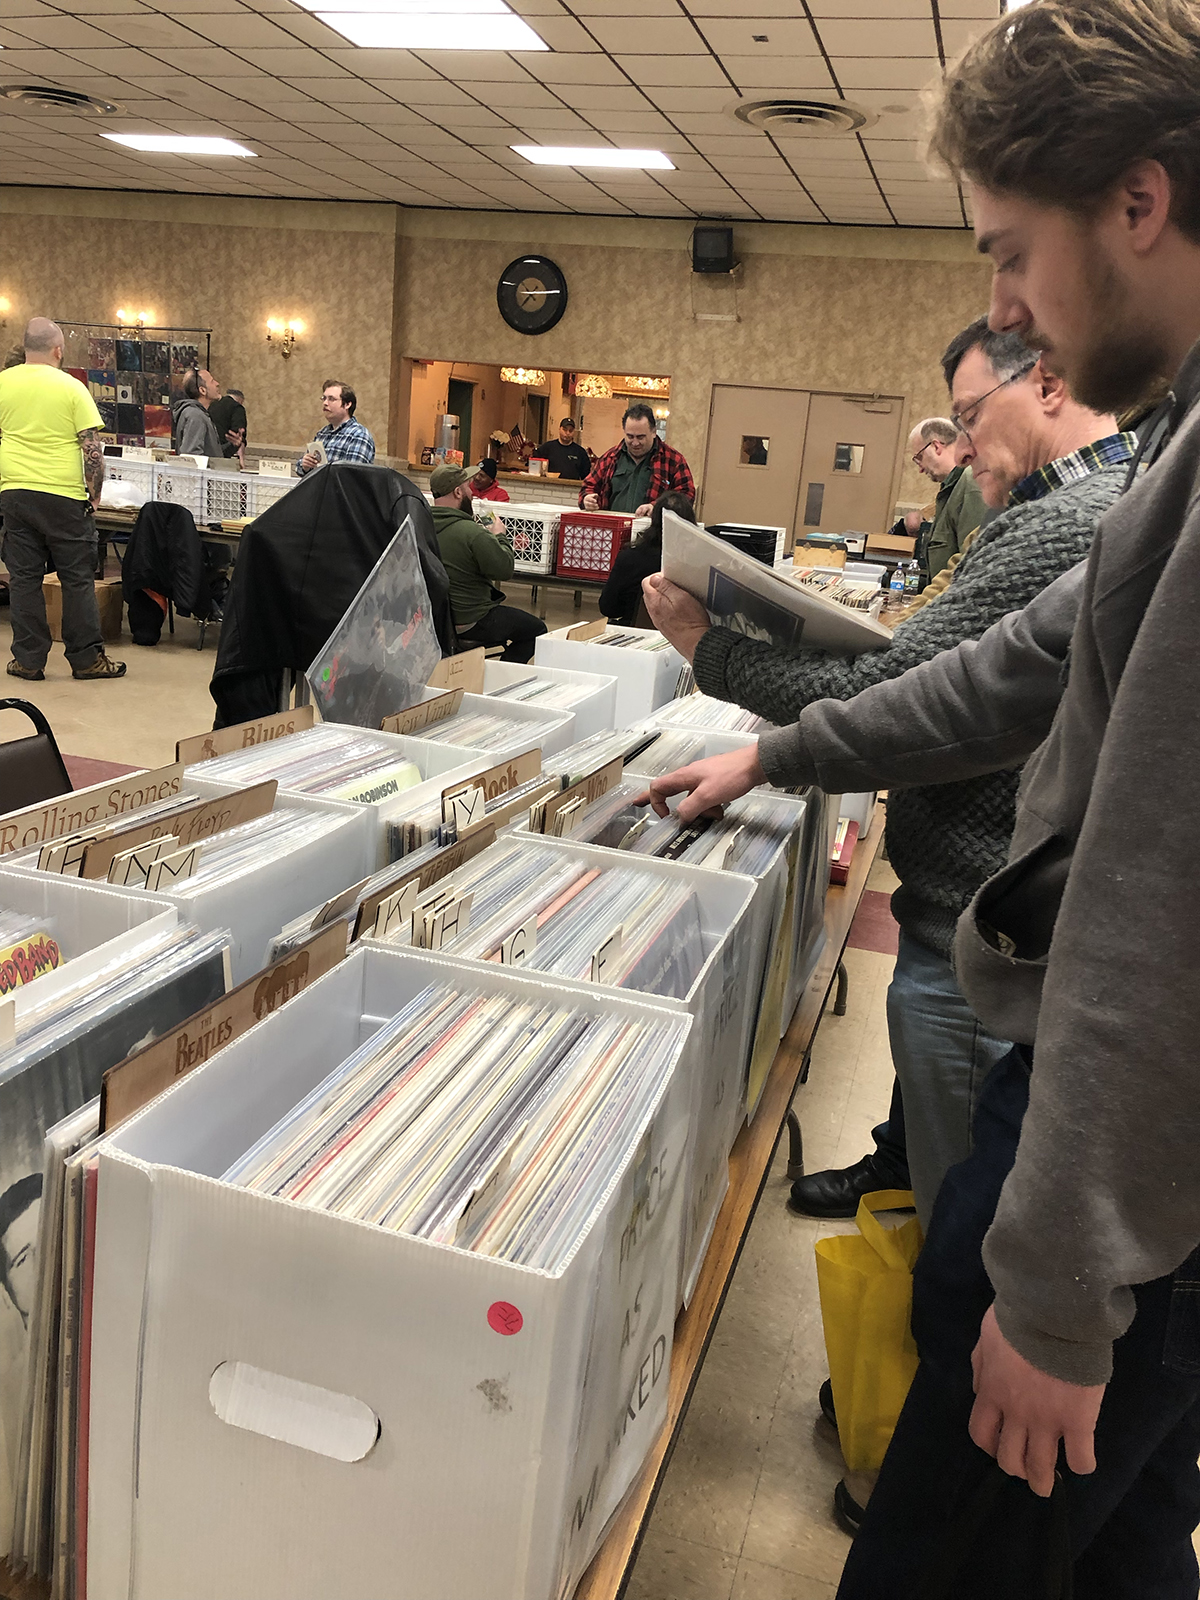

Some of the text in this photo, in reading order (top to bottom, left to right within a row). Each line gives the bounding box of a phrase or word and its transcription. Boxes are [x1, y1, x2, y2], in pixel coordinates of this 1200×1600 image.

[242, 720, 295, 749] Blues
[0, 777, 180, 855] Rolling Stones
[156, 848, 196, 890] M
[383, 886, 408, 935] K
[440, 899, 463, 947] H
[11, 936, 59, 985] BAND
[510, 929, 526, 964] G
[174, 1015, 233, 1076] BEATLES
[200, 1014, 213, 1030] THE
[568, 1333, 667, 1547] MKED
